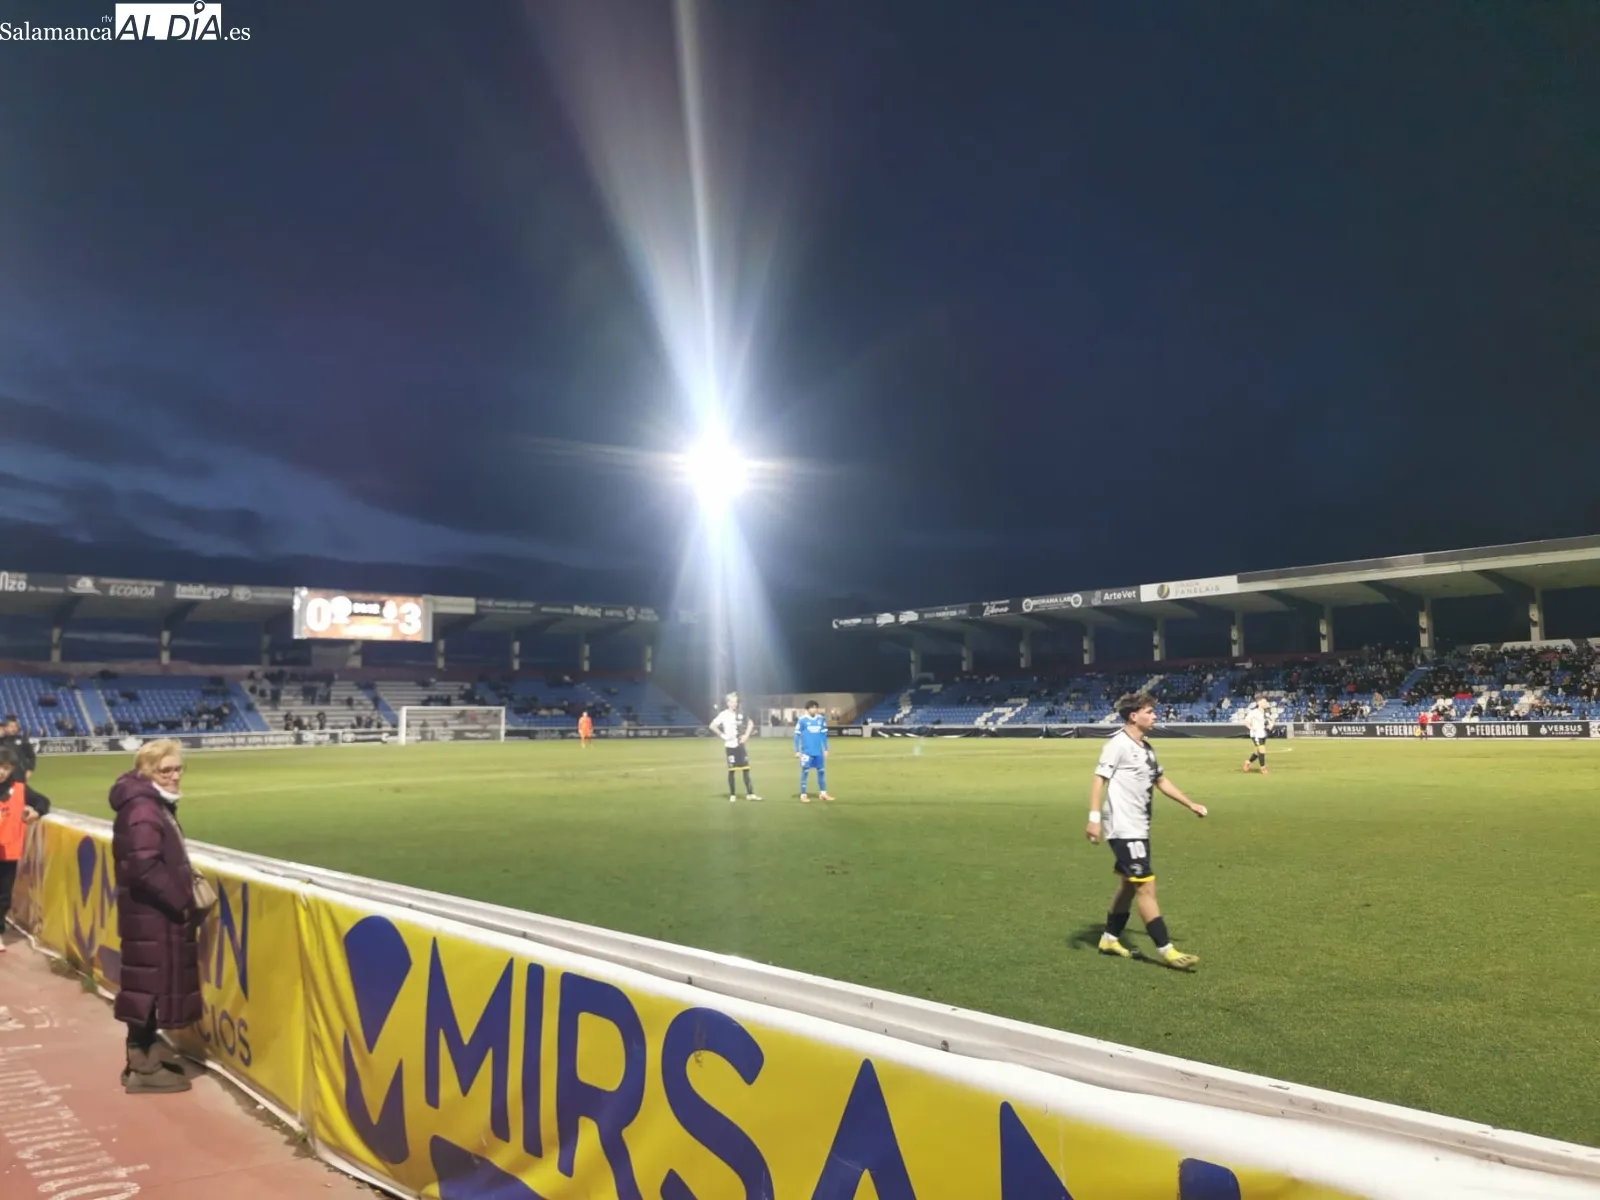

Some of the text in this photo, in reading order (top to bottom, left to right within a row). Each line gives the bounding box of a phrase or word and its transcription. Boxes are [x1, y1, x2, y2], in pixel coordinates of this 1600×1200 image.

[1103, 589, 1137, 601] ArteVet
[398, 602, 421, 635] 3
[1338, 725, 1366, 733] VERSUS
[1476, 723, 1529, 736] FEDERACIÓN
[1547, 724, 1583, 732] VERSUS
[1127, 840, 1147, 860] 10
